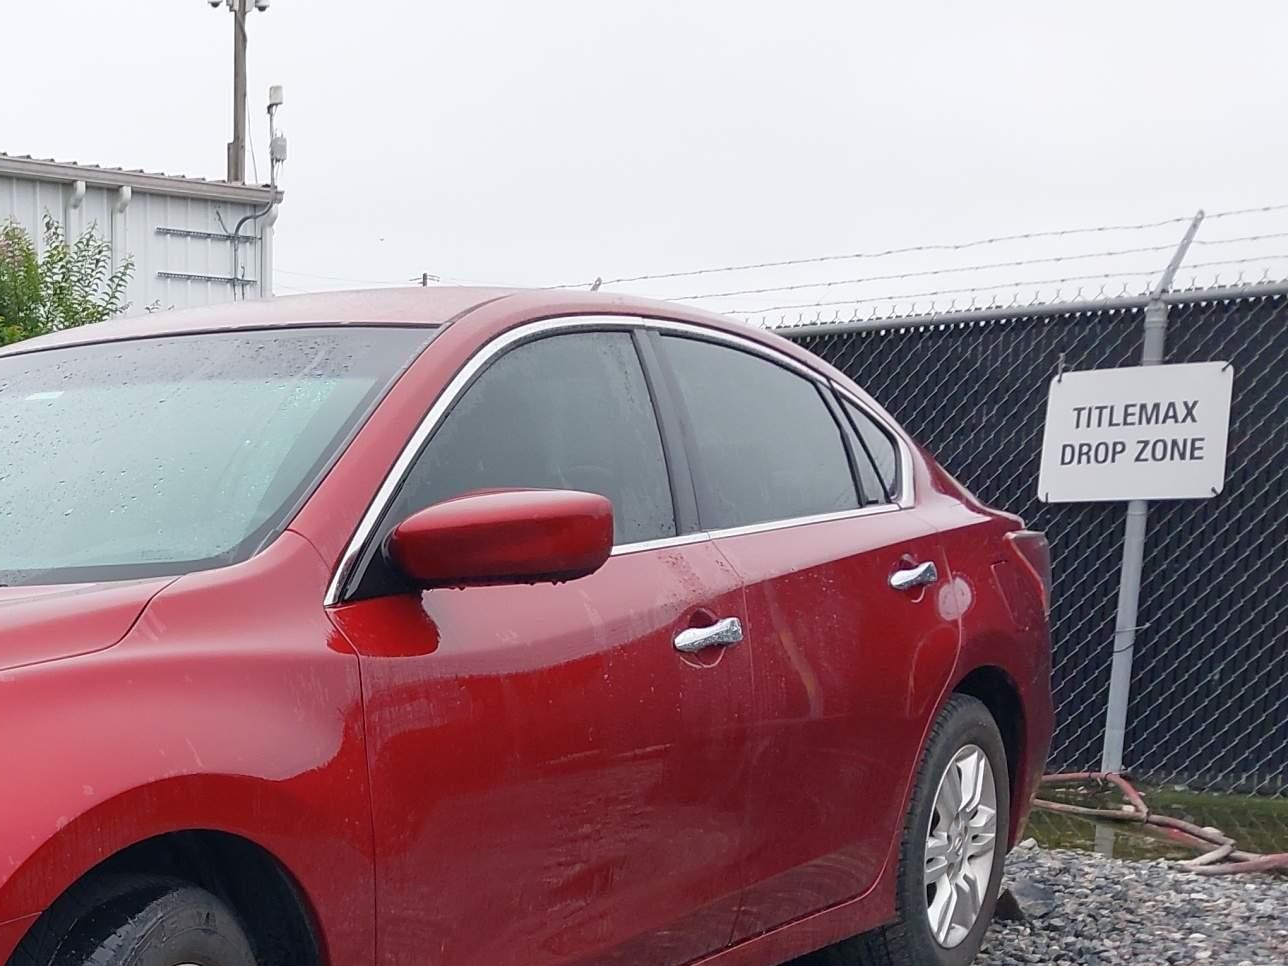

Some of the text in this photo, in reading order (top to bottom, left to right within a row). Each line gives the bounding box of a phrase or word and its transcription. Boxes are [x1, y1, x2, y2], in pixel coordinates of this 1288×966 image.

[1073, 400, 1199, 430] TITLEMAX
[1060, 437, 1205, 466] DROP ZONE
